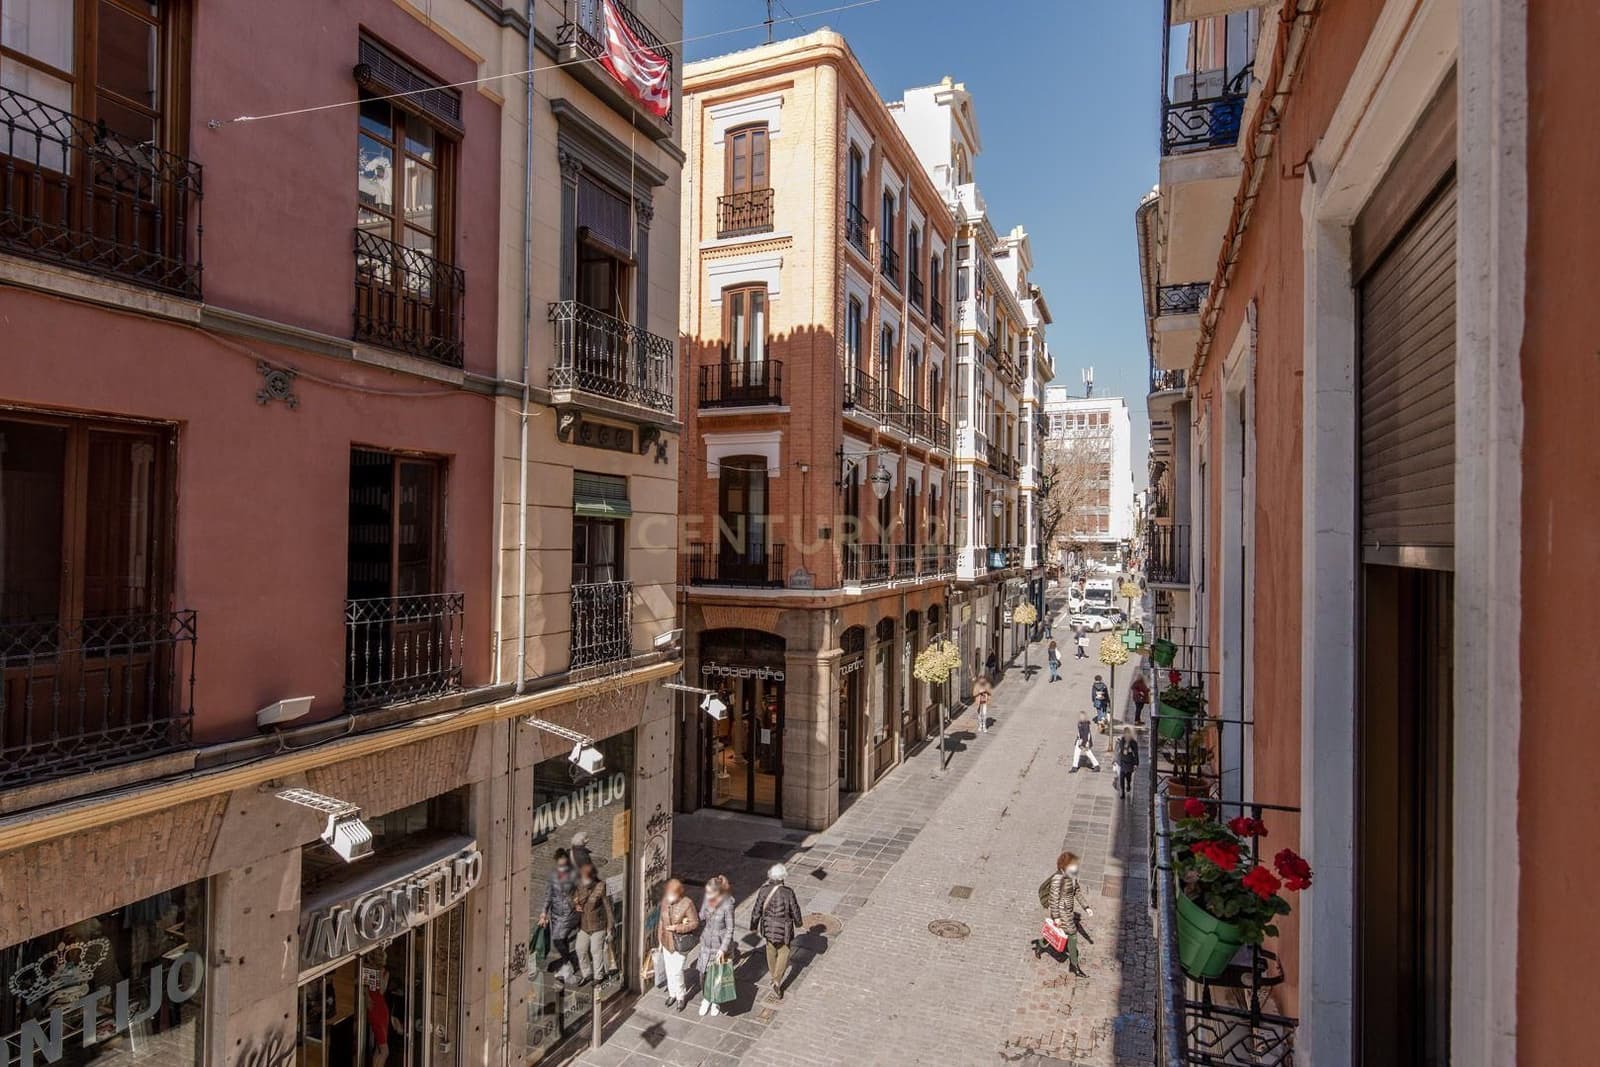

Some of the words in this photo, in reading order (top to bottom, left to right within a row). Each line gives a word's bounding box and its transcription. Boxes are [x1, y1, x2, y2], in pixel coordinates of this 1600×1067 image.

[702, 662, 784, 682] encuentro
[533, 772, 625, 839] MONTIJO
[304, 851, 482, 965] MONTIJO
[0, 951, 205, 1067] NTIJO
